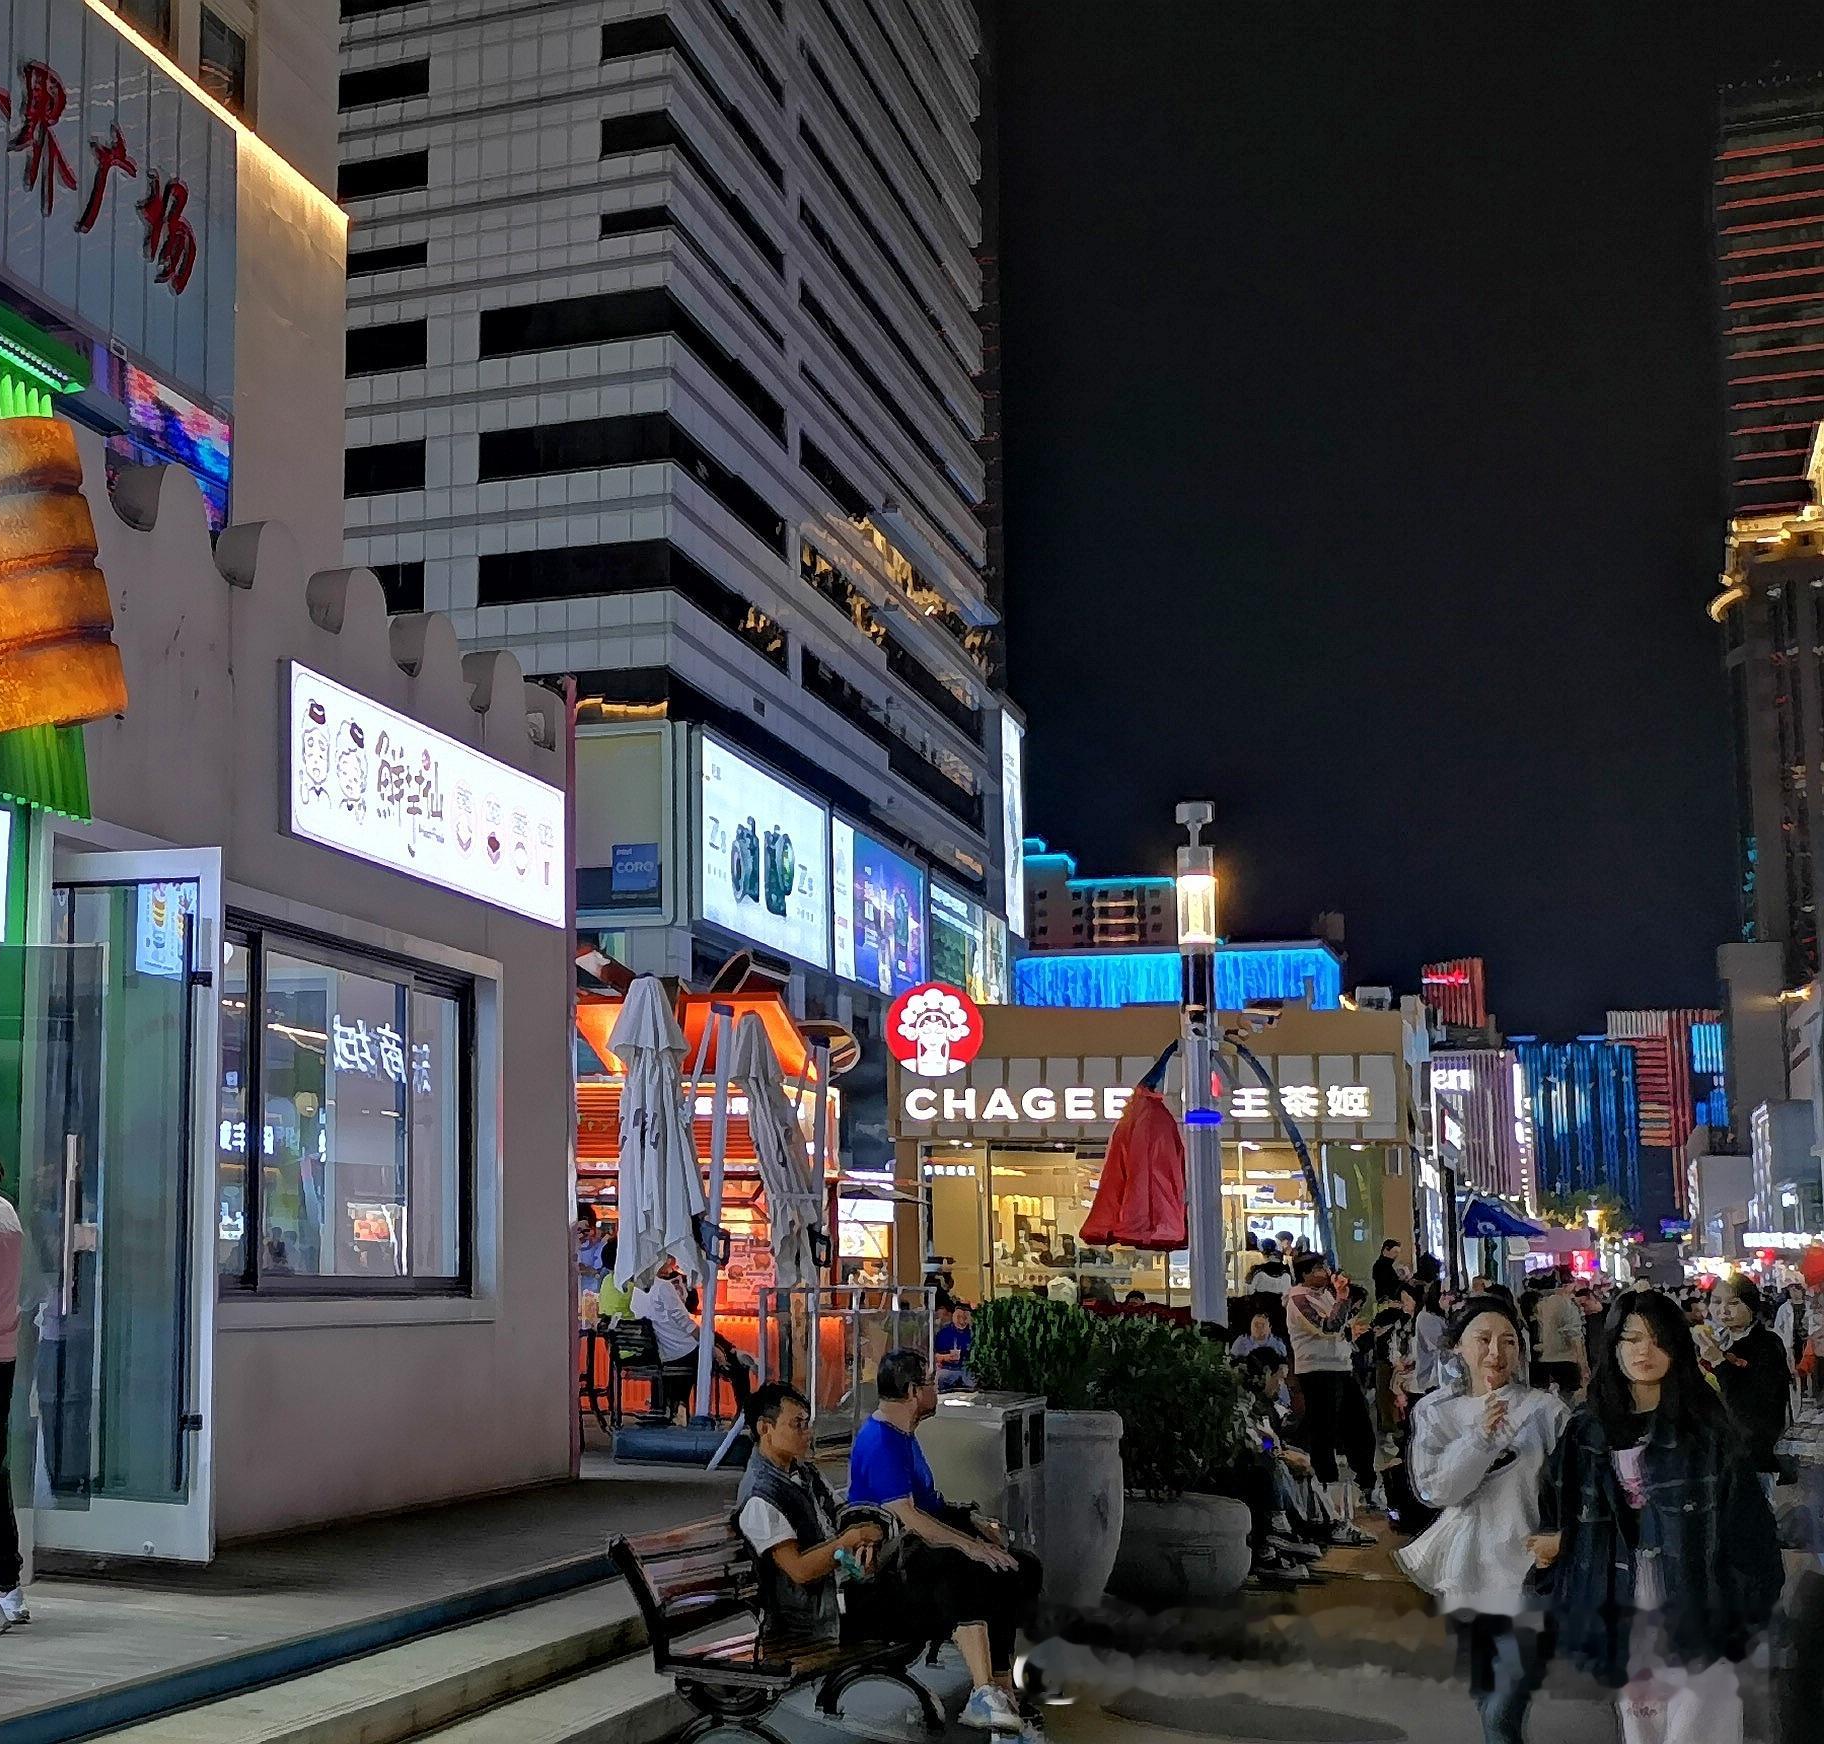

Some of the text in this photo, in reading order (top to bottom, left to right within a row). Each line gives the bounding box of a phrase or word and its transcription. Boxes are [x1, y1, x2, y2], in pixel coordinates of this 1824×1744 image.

[376, 730, 443, 858] 鲜芋仙
[904, 1087, 1135, 1121] CHAGEE
[1181, 1085, 1372, 1118] 王茶姬
